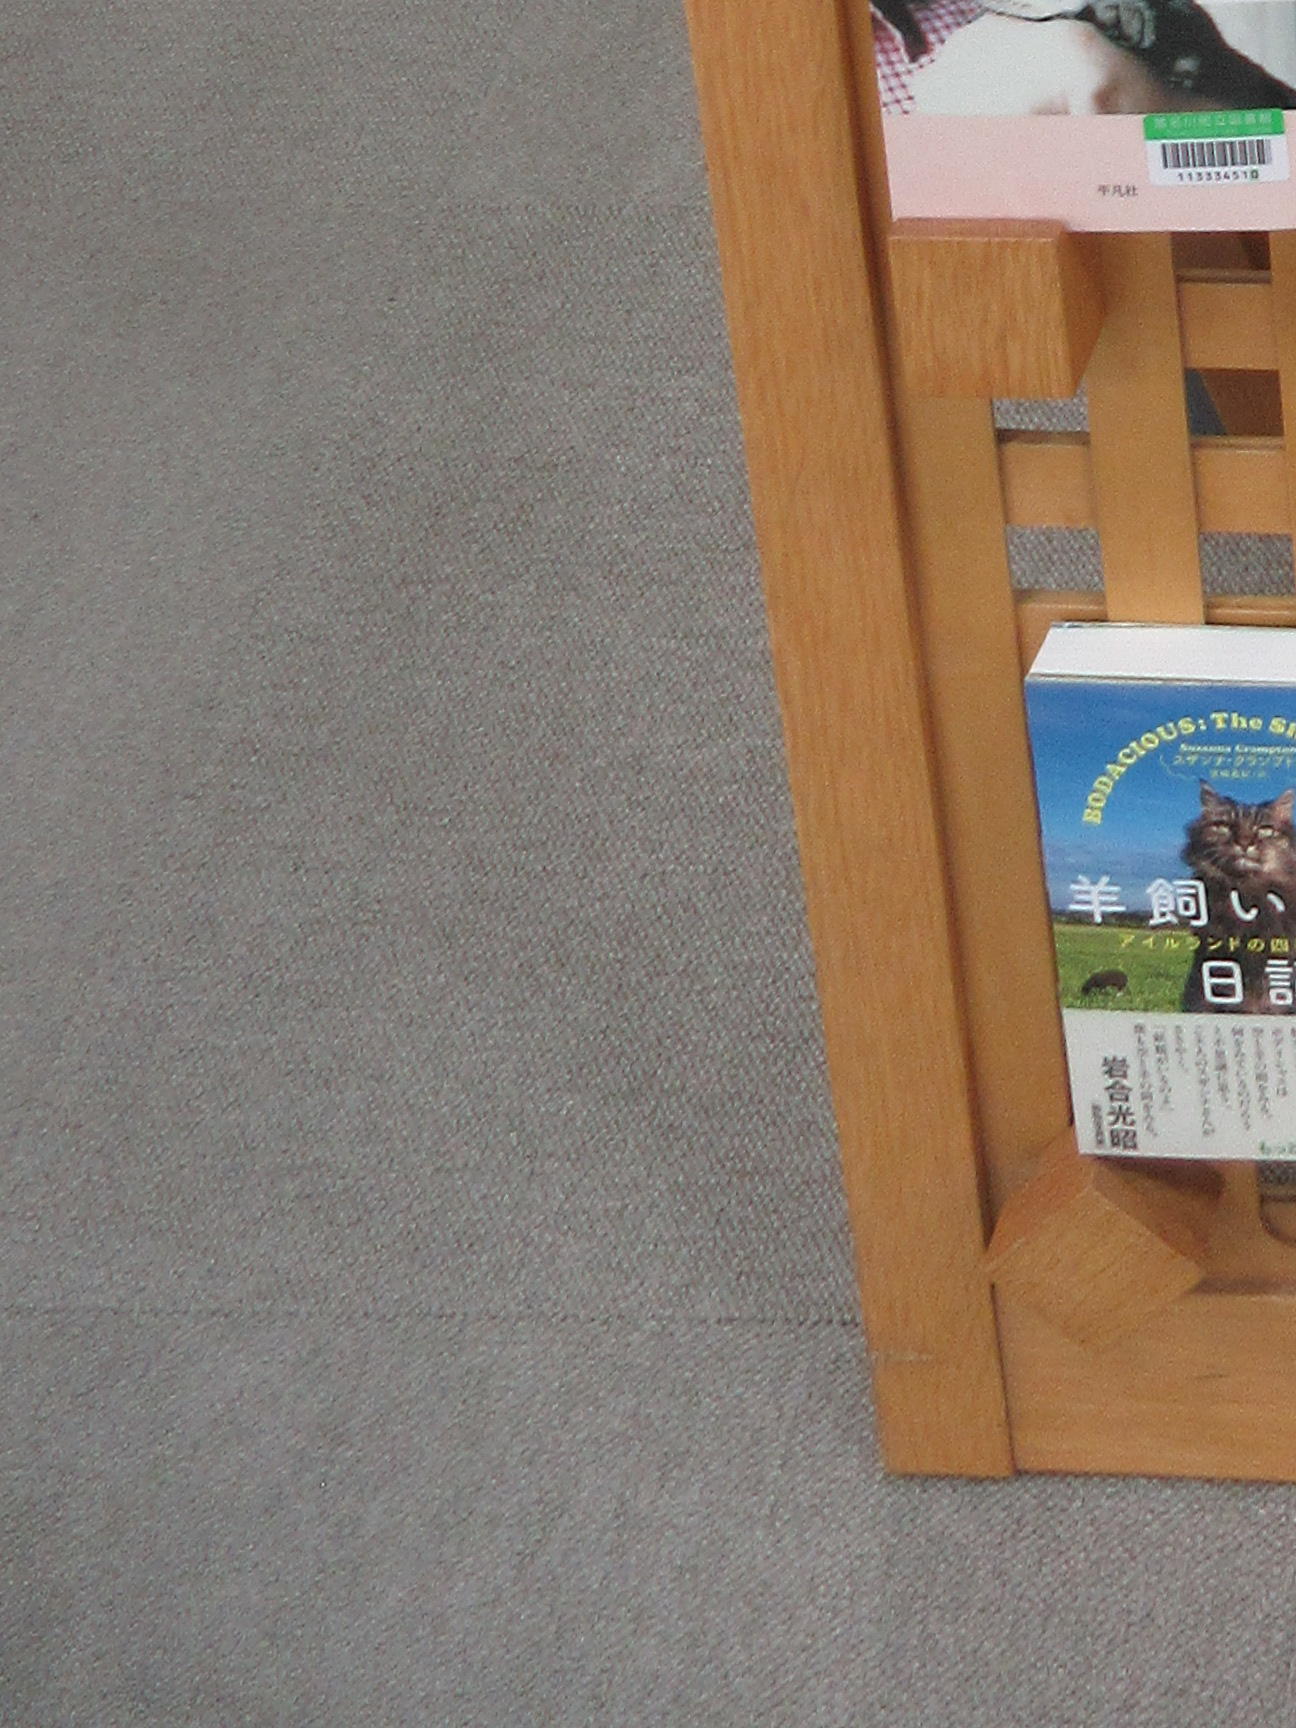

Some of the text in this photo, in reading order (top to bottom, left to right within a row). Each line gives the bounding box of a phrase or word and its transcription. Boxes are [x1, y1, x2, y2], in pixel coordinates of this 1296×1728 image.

[1177, 170, 1260, 183] 113334510
[1098, 184, 1139, 197] 平凡社
[1209, 710, 1263, 730] The
[1101, 1055, 1138, 1151] 岩合光昭
